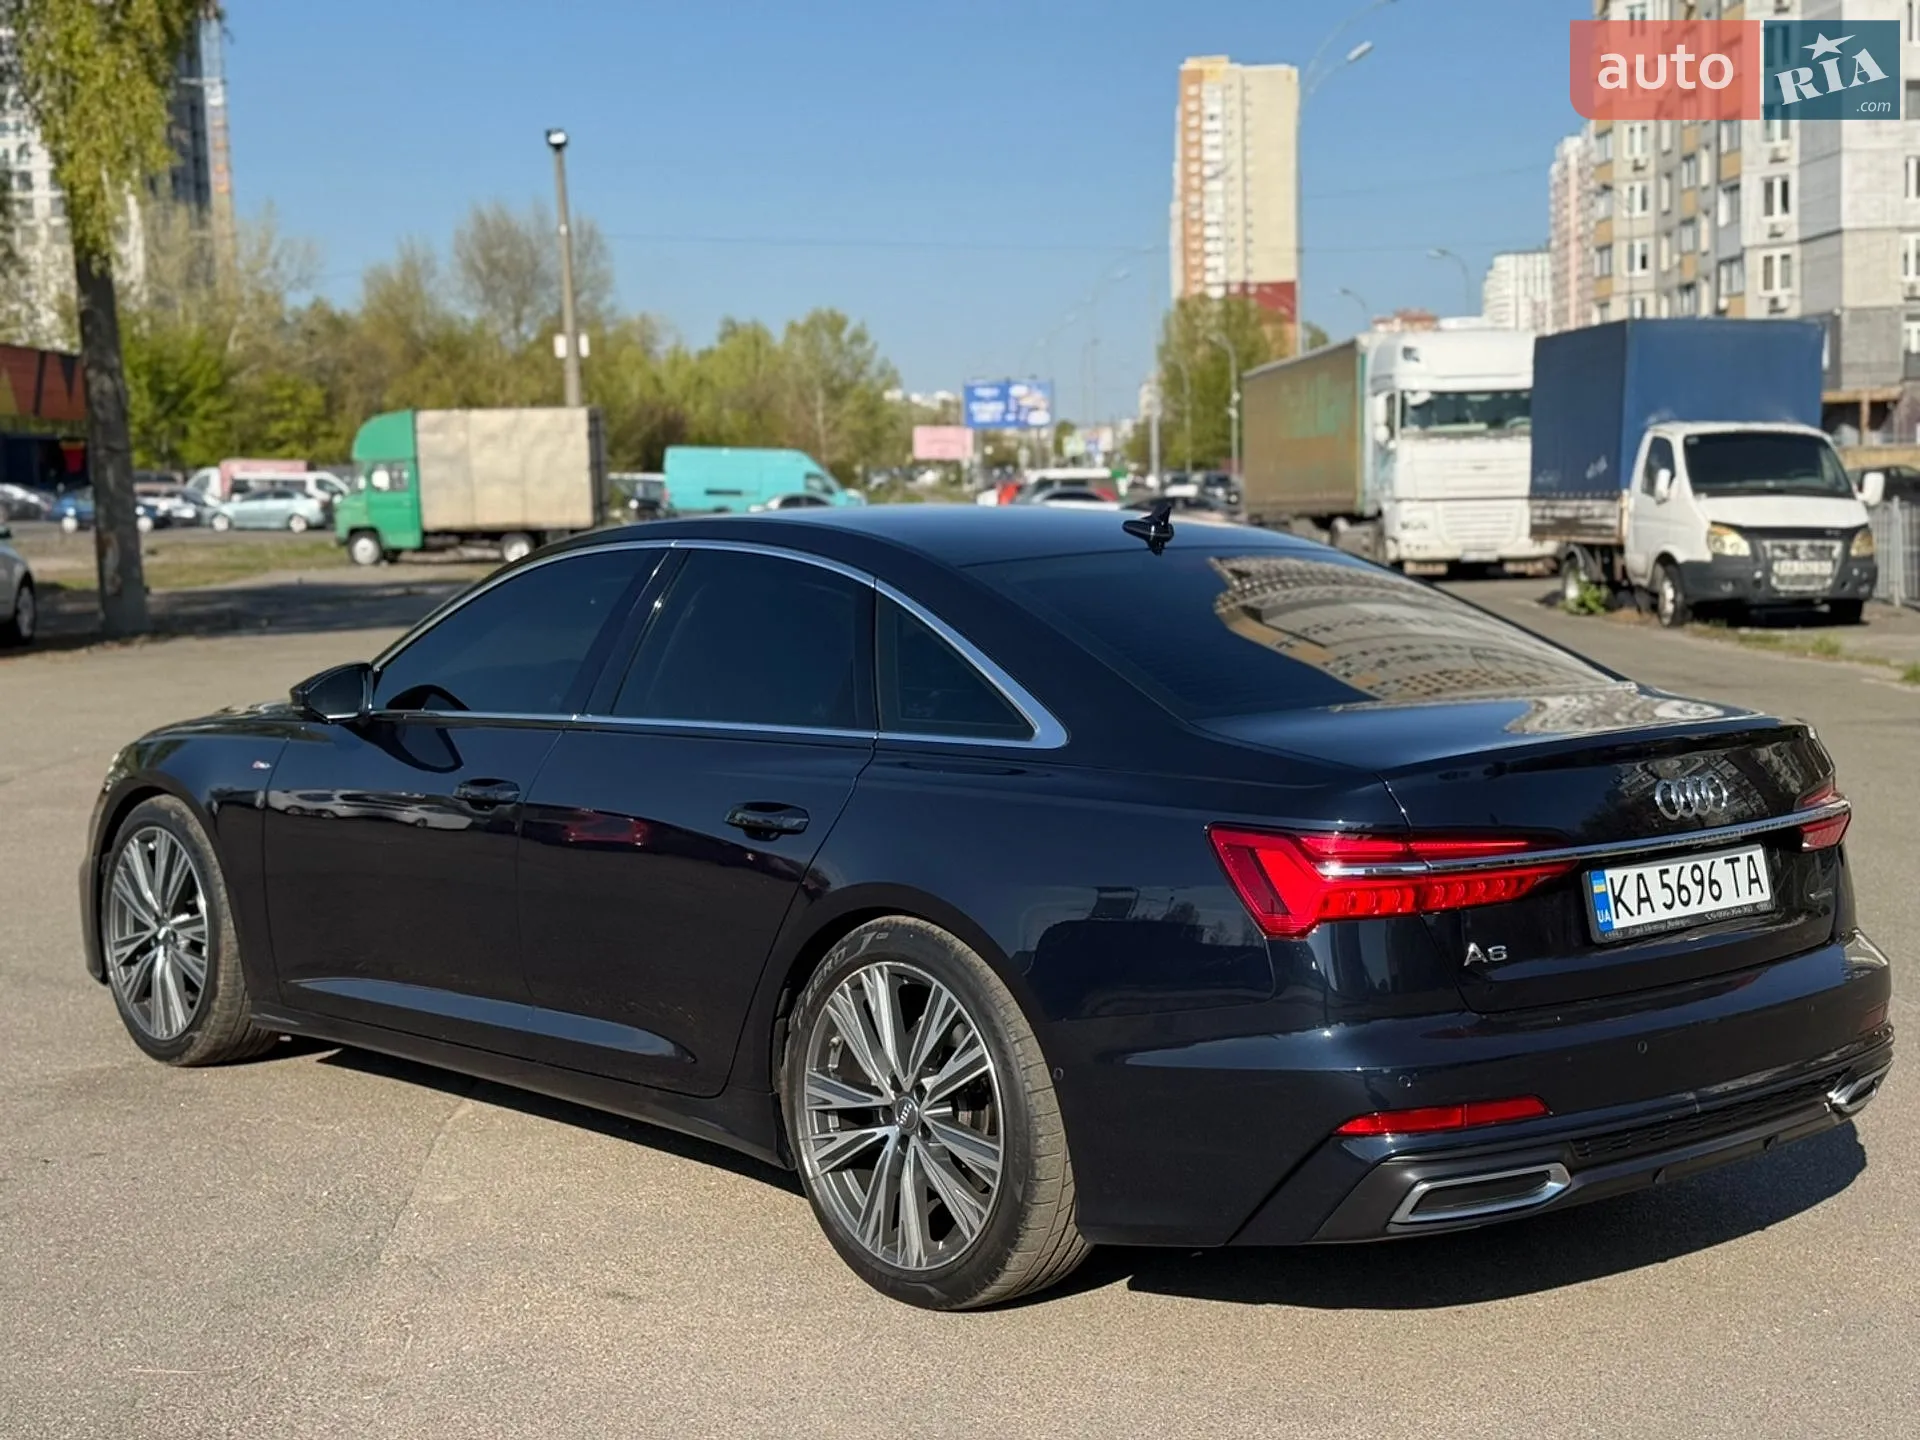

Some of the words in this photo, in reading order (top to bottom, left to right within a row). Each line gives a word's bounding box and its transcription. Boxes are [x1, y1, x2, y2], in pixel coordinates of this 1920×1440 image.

[1609, 872, 1656, 919] KA
[1658, 860, 1722, 910] 5696
[1724, 854, 1764, 898] TA
[1597, 909, 1612, 923] UA
[1463, 942, 1507, 966] A6
